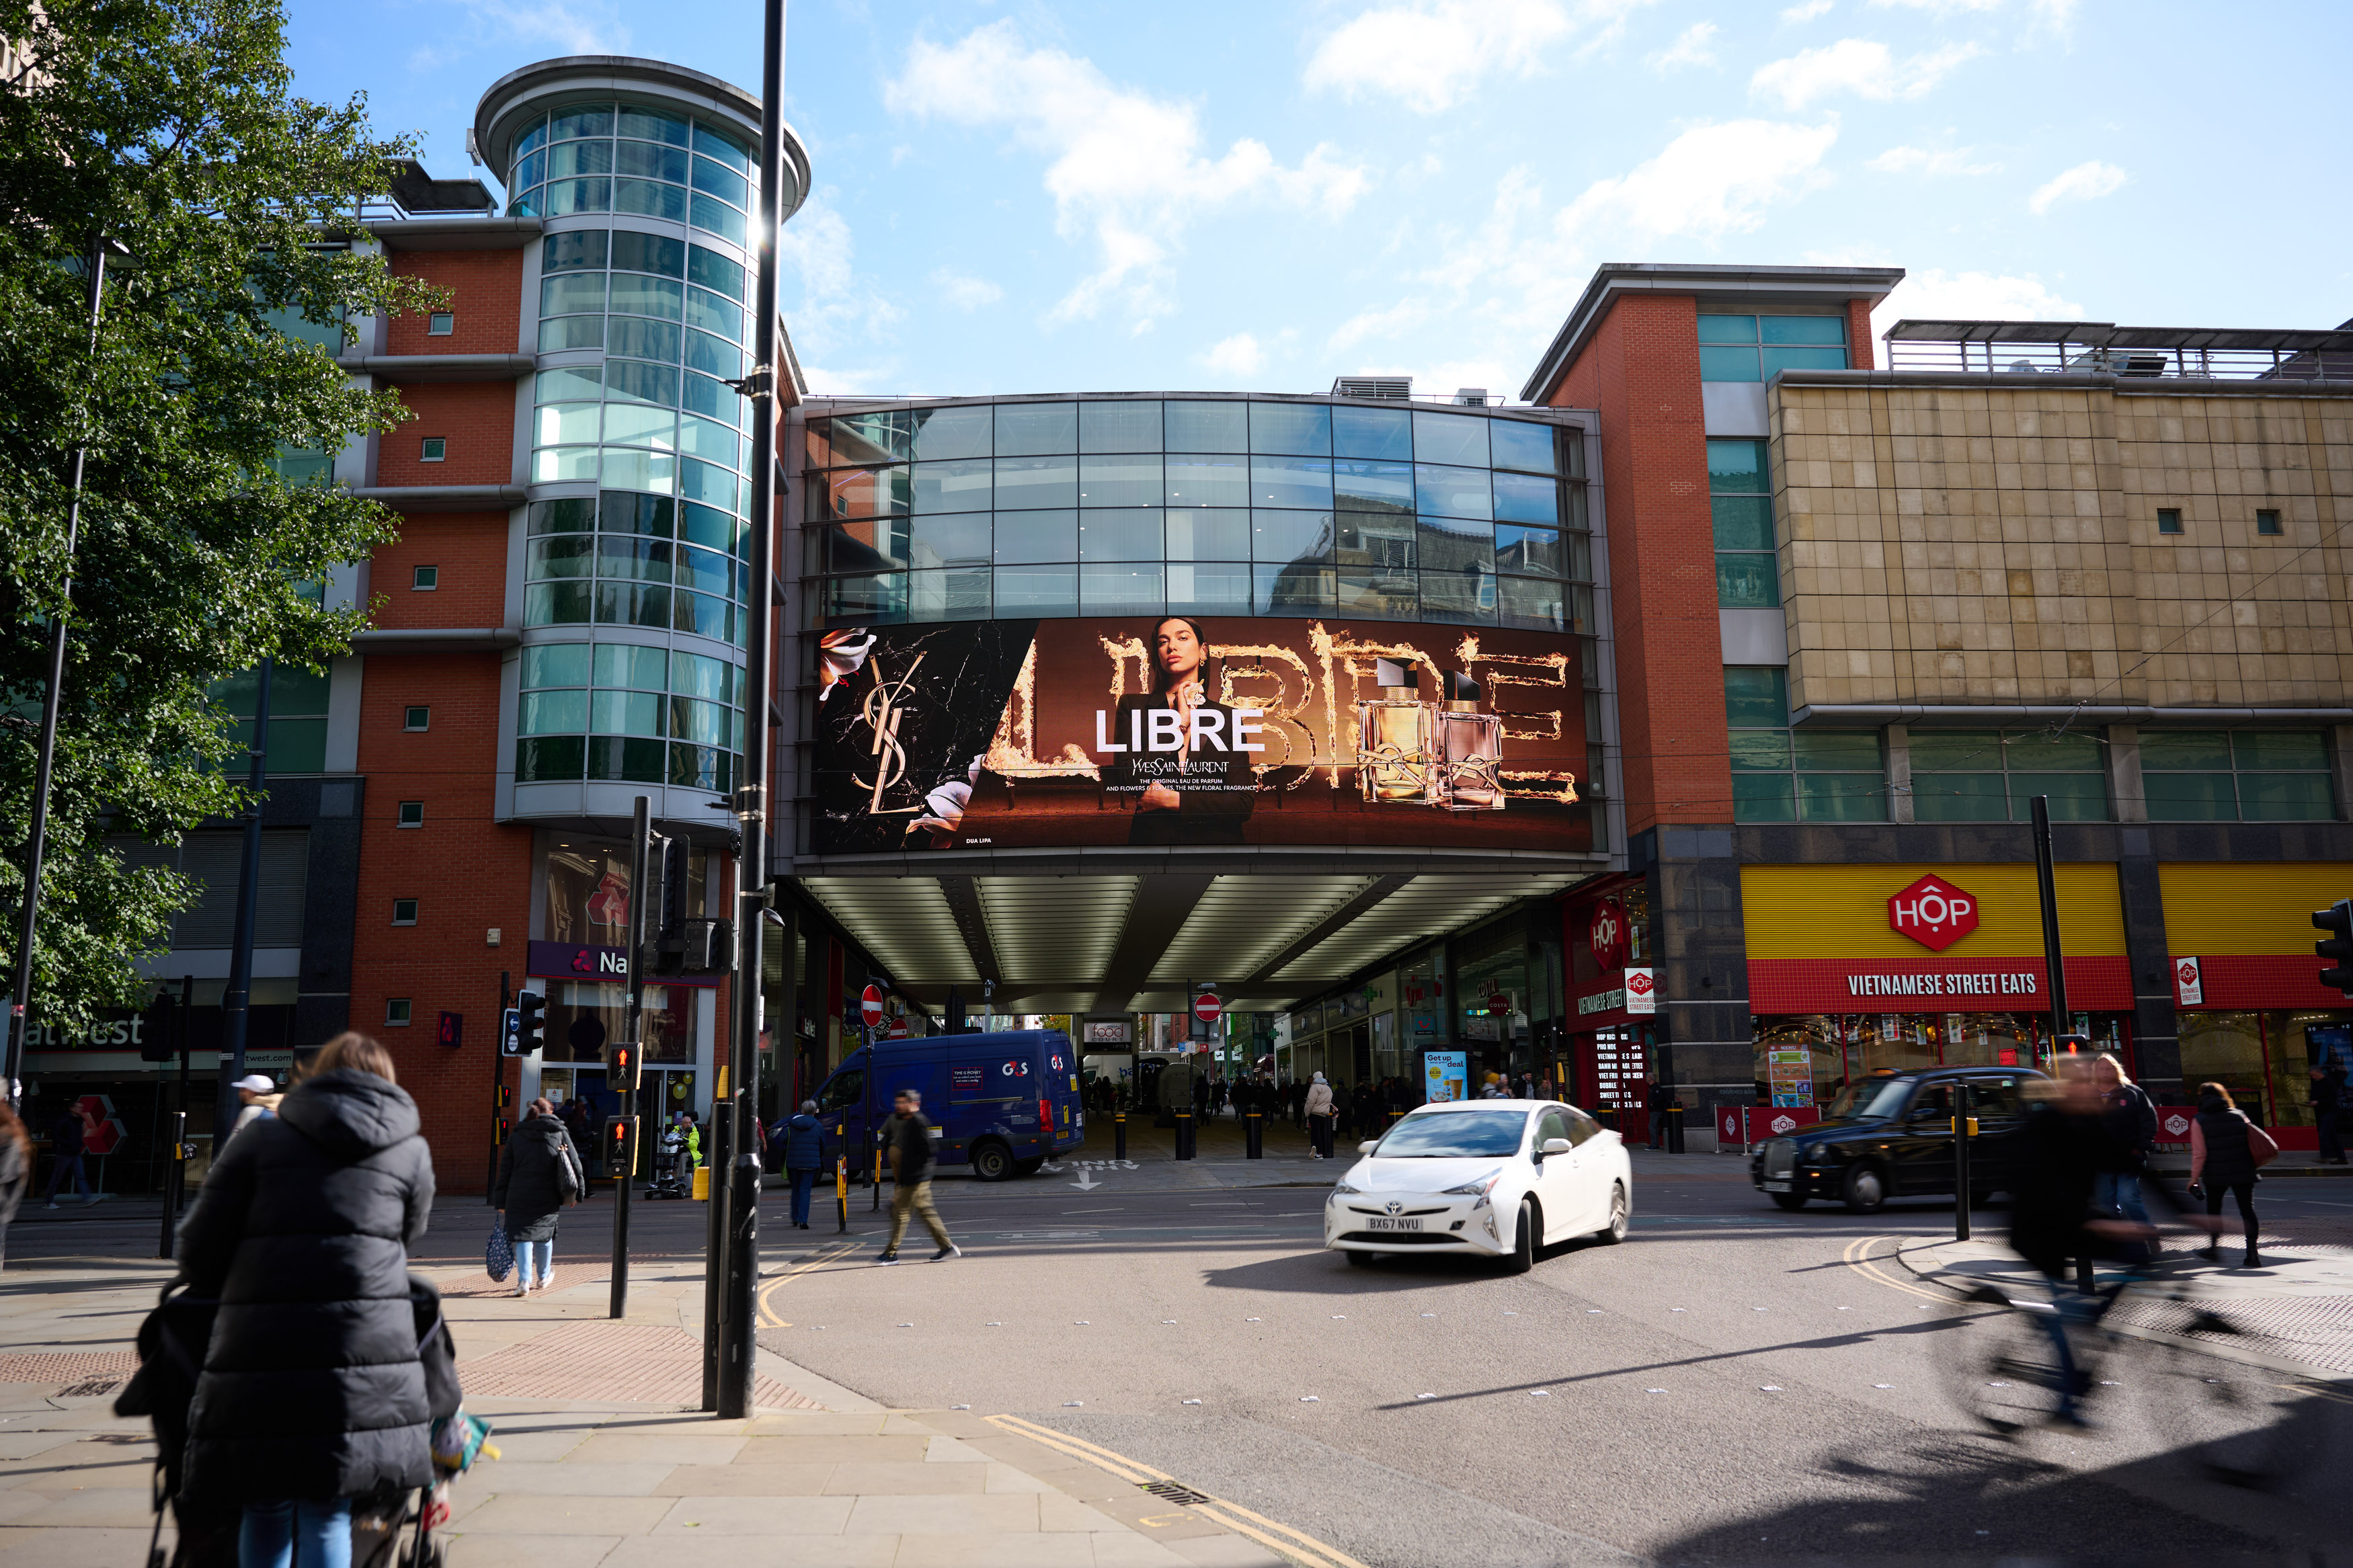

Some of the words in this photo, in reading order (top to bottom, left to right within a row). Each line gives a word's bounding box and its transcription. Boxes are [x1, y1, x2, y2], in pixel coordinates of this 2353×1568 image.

[1096, 709, 1265, 752] LIBRE
[600, 952, 627, 974] Na
[1478, 979, 1496, 997] COSTA
[1848, 975, 1943, 995] VIETNAMESE
[1946, 973, 1997, 995] STREET
[2001, 973, 2036, 993] EATS
[1578, 991, 1606, 1015] VIETNAMESE
[1606, 988, 1623, 1009] STREET
[27, 1013, 144, 1046] atWest
[1092, 1023, 1123, 1037] food
[1002, 1061, 1029, 1077] G4S
[1051, 1055, 1064, 1071] G4S
[1369, 1219, 1395, 1229] BX67
[1398, 1219, 1419, 1229] NVU
